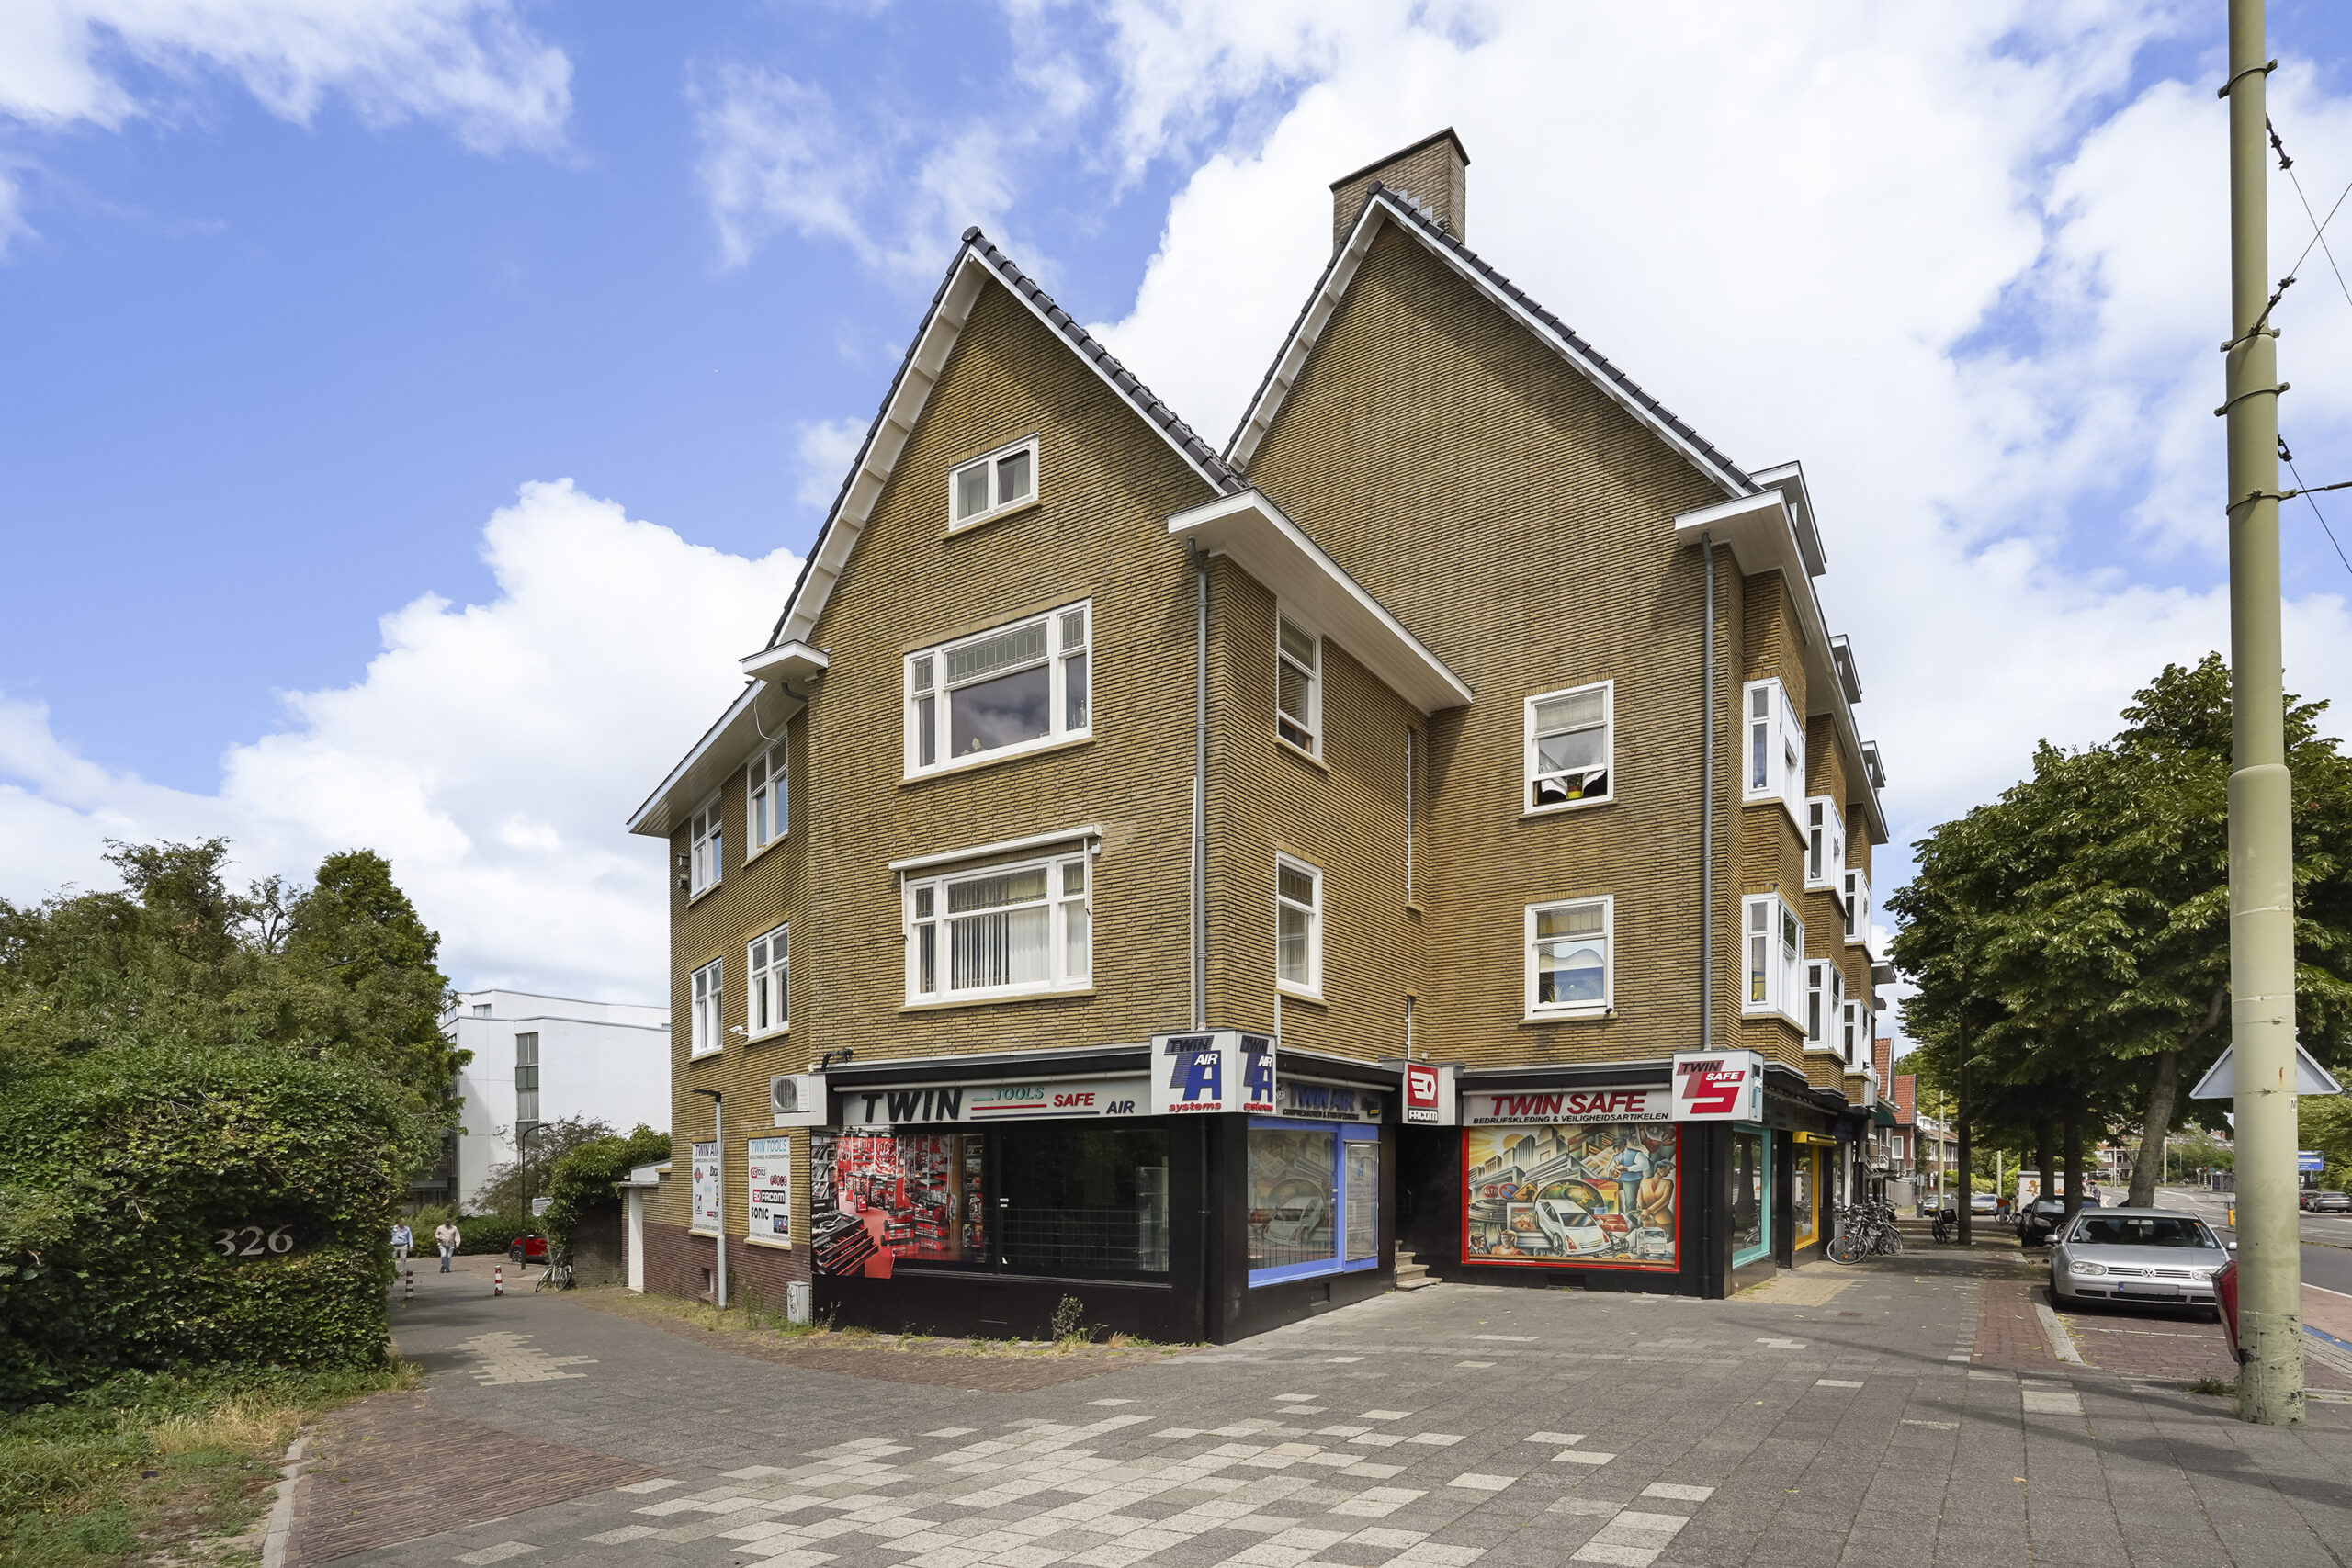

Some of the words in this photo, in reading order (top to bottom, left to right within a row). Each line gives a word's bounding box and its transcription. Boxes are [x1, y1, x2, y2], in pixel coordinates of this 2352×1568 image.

[1170, 1039, 1210, 1052] TWIN
[1194, 1054, 1219, 1066] AIR
[1259, 1055, 1272, 1067] AIR
[1681, 1062, 1721, 1073] TWIN
[1705, 1072, 1740, 1081] SAFE
[995, 1087, 1044, 1101] TOOLS
[1053, 1092, 1095, 1108] SAFE
[1289, 1084, 1329, 1109] TWIN
[1329, 1089, 1356, 1112] AIR
[861, 1089, 963, 1123] TWIN
[1106, 1100, 1136, 1115] AIR
[1169, 1102, 1222, 1112] systems
[1243, 1102, 1273, 1111] systems
[1491, 1094, 1564, 1116] TWIN
[1566, 1090, 1647, 1114] SAFE
[1473, 1115, 1550, 1124] BEDRIJFSKLEDING
[1562, 1112, 1668, 1122] VEILIGHEIDSARTIKELEN
[695, 1145, 709, 1156] TWIN
[752, 1140, 765, 1153] TWIN
[767, 1139, 786, 1152] TOOLS
[215, 1224, 294, 1257] 326
